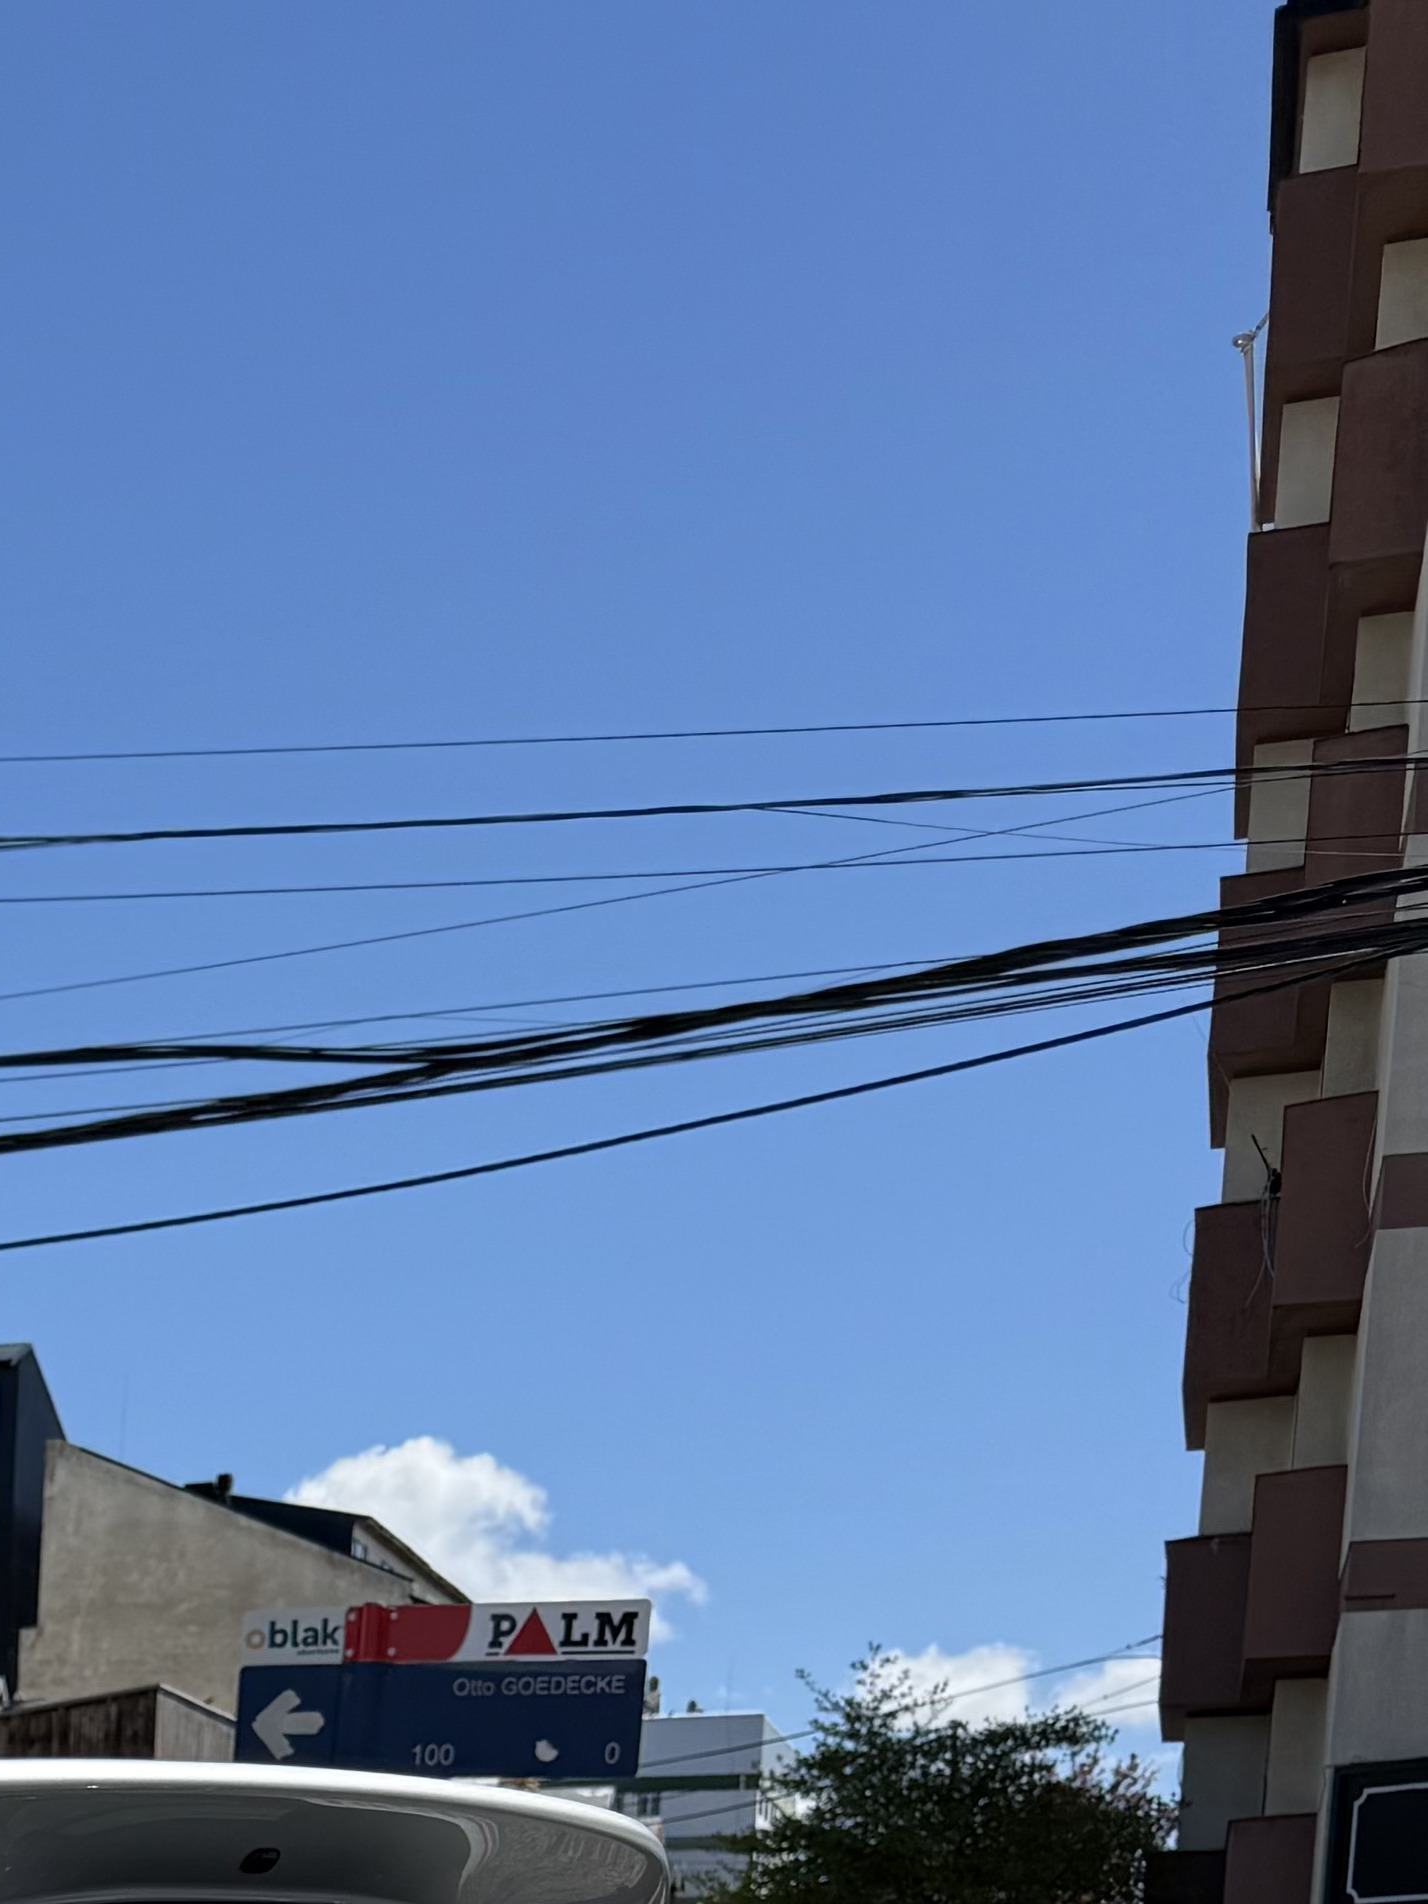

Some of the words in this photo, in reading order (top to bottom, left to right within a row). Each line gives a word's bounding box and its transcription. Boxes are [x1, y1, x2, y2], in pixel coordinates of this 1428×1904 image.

[245, 1617, 342, 1650] oblak
[453, 1677, 495, 1697] Otto
[501, 1675, 627, 1696] GOEDECKE
[412, 1743, 456, 1767] 100
[604, 1741, 622, 1765] 0
